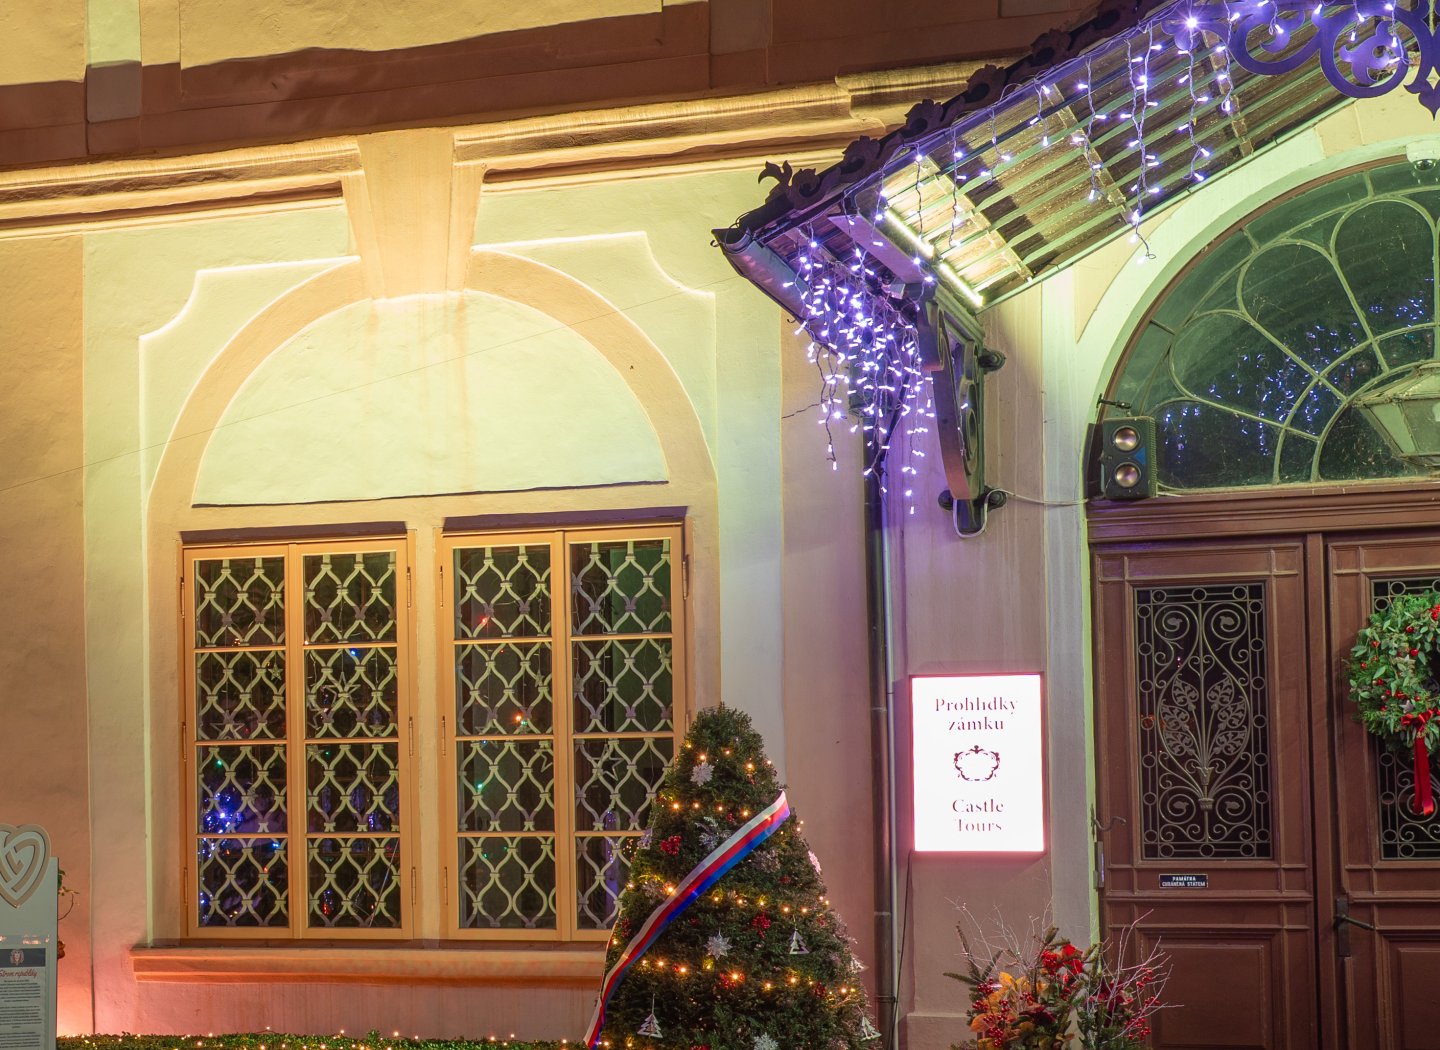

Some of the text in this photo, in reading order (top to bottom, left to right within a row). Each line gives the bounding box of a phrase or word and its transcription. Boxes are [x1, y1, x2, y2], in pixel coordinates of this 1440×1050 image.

[948, 716, 1004, 731] zámku
[952, 798, 1004, 813] Castle
[954, 818, 1003, 832] Tours
